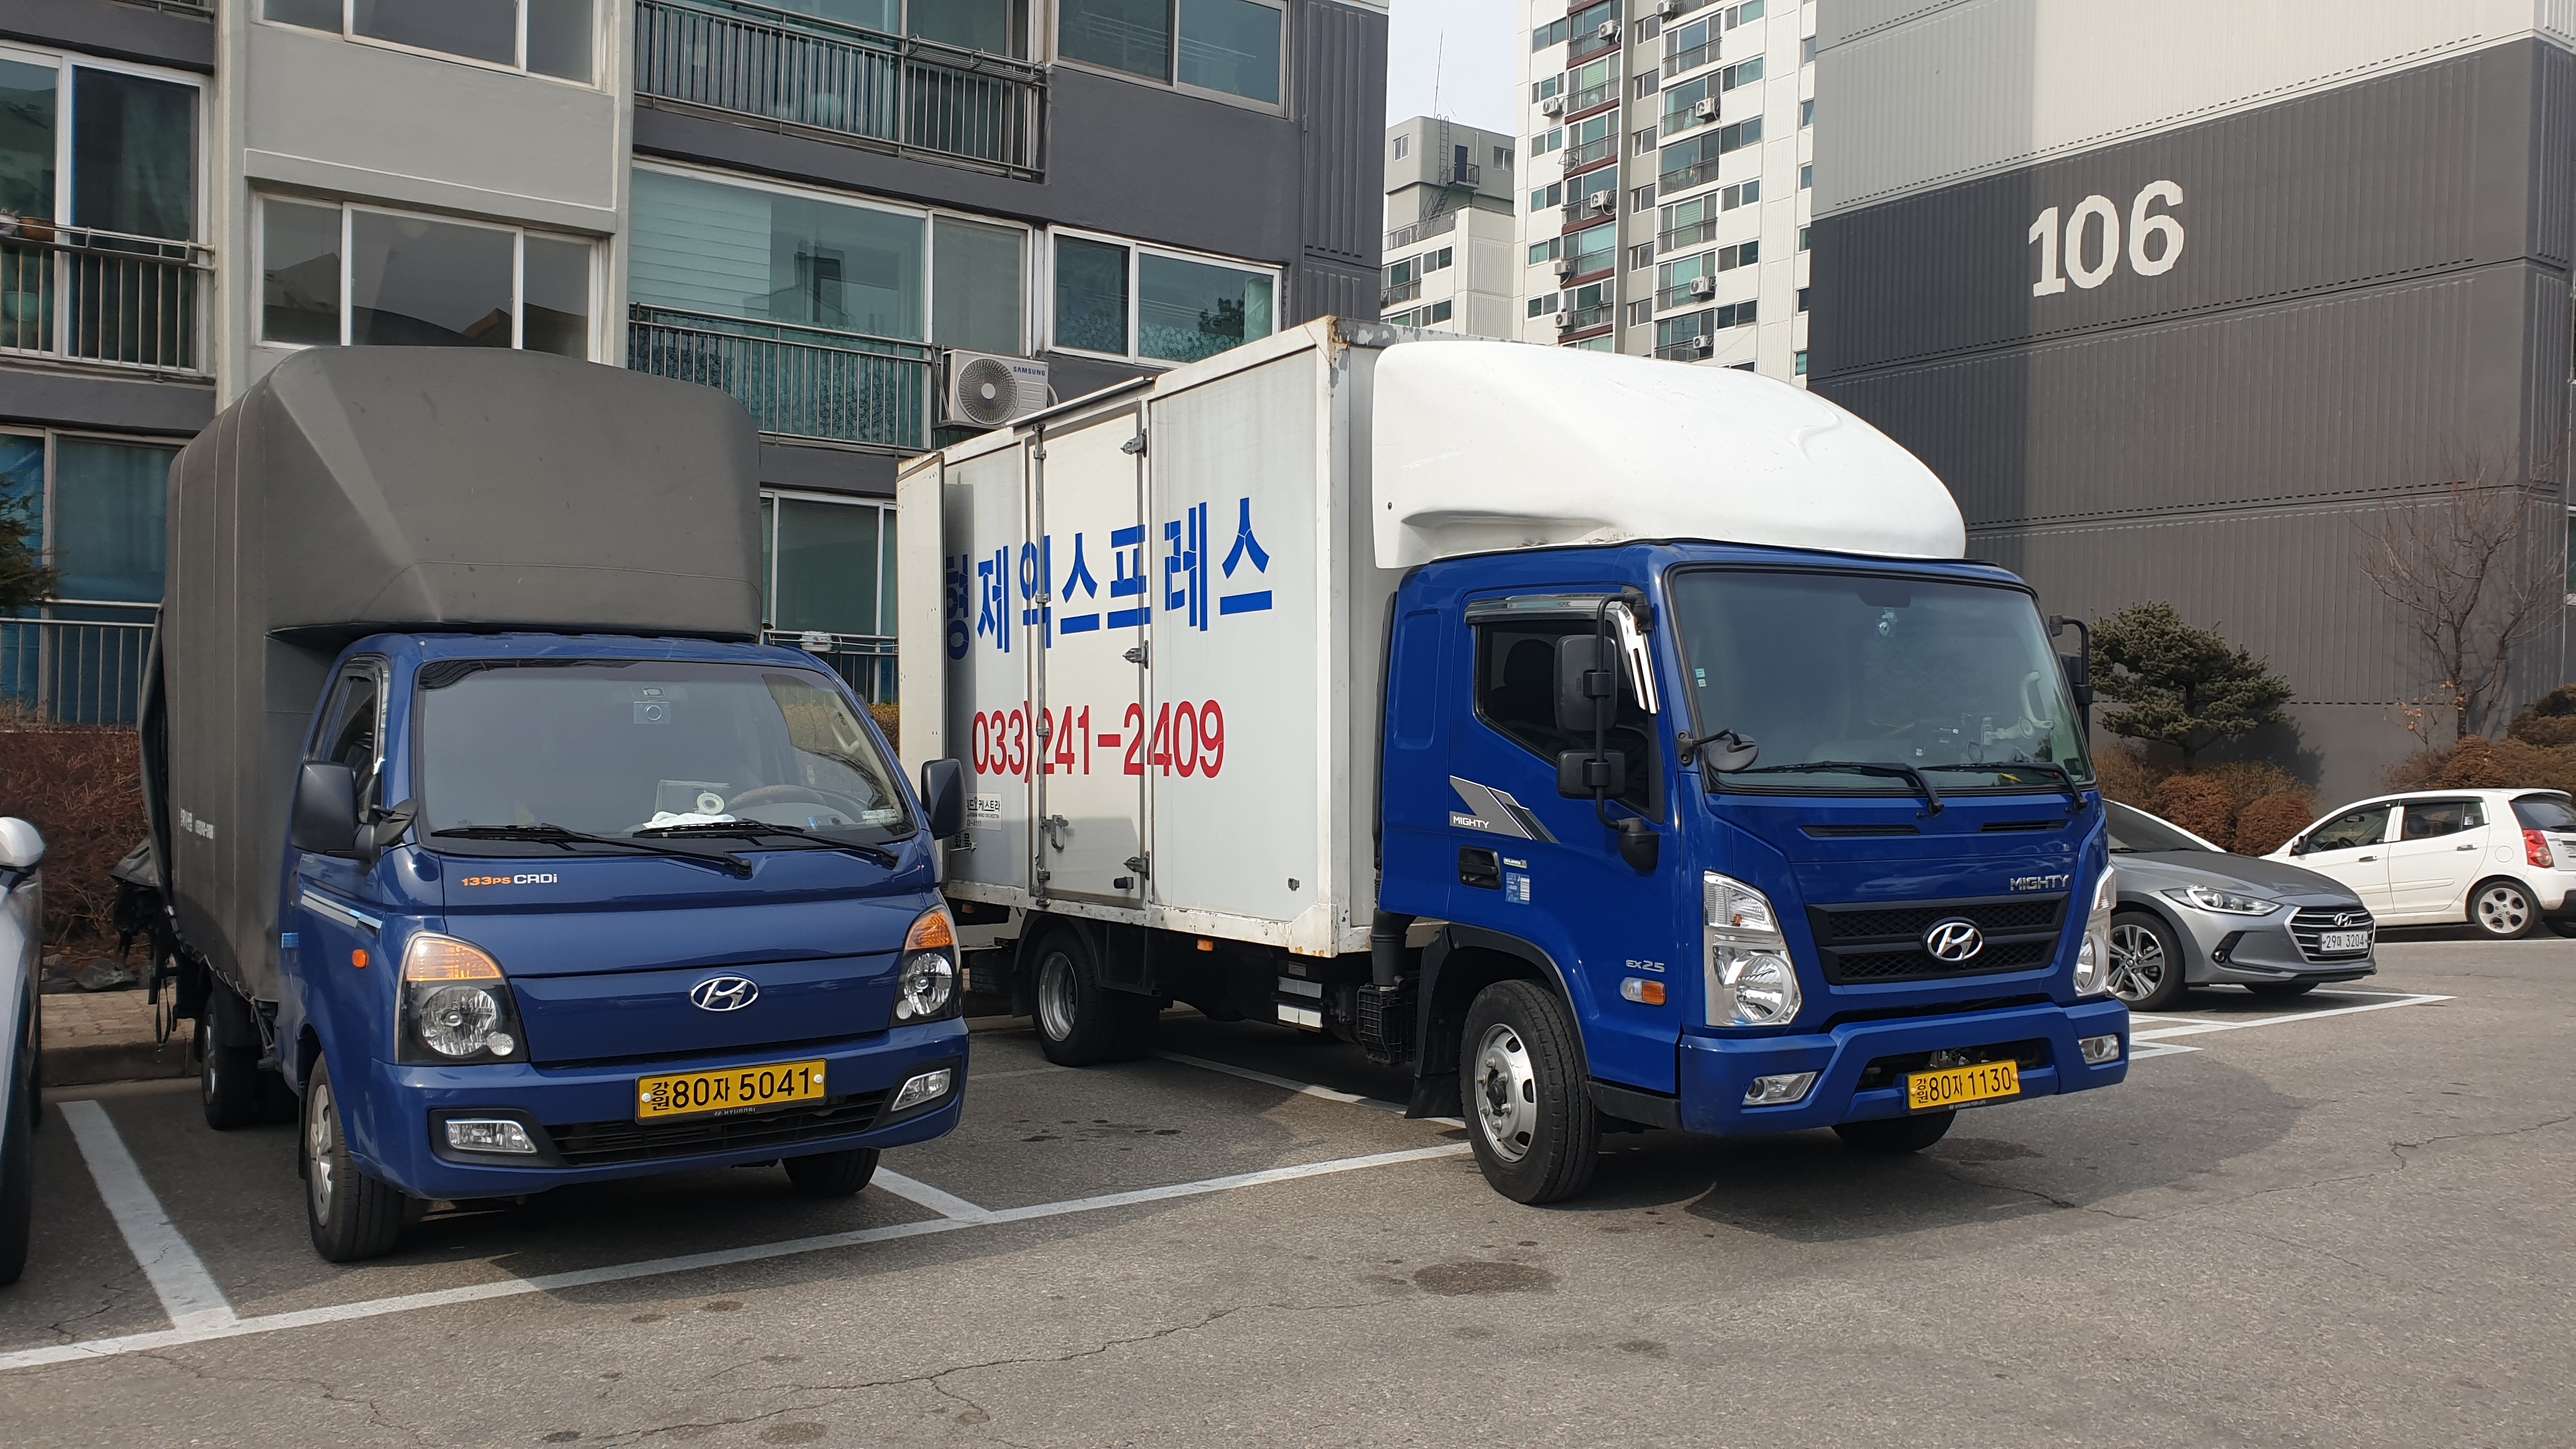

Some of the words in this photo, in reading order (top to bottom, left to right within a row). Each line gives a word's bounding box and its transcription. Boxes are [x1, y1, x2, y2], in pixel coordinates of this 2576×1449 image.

[2028, 180, 2184, 296] 106
[1013, 366, 1045, 376] SAMSUNG
[946, 497, 1273, 661] 형제익스프레스
[1453, 815, 1489, 829] MIGHTY
[462, 877, 511, 886] 133PS
[514, 873, 558, 884] CRDi
[2010, 874, 2069, 891] MIGHTY
[2326, 935, 2342, 948] 29마
[2346, 934, 2364, 947] 3204
[739, 1068, 809, 1101] 5041
[1968, 1066, 2011, 1095] 1130
